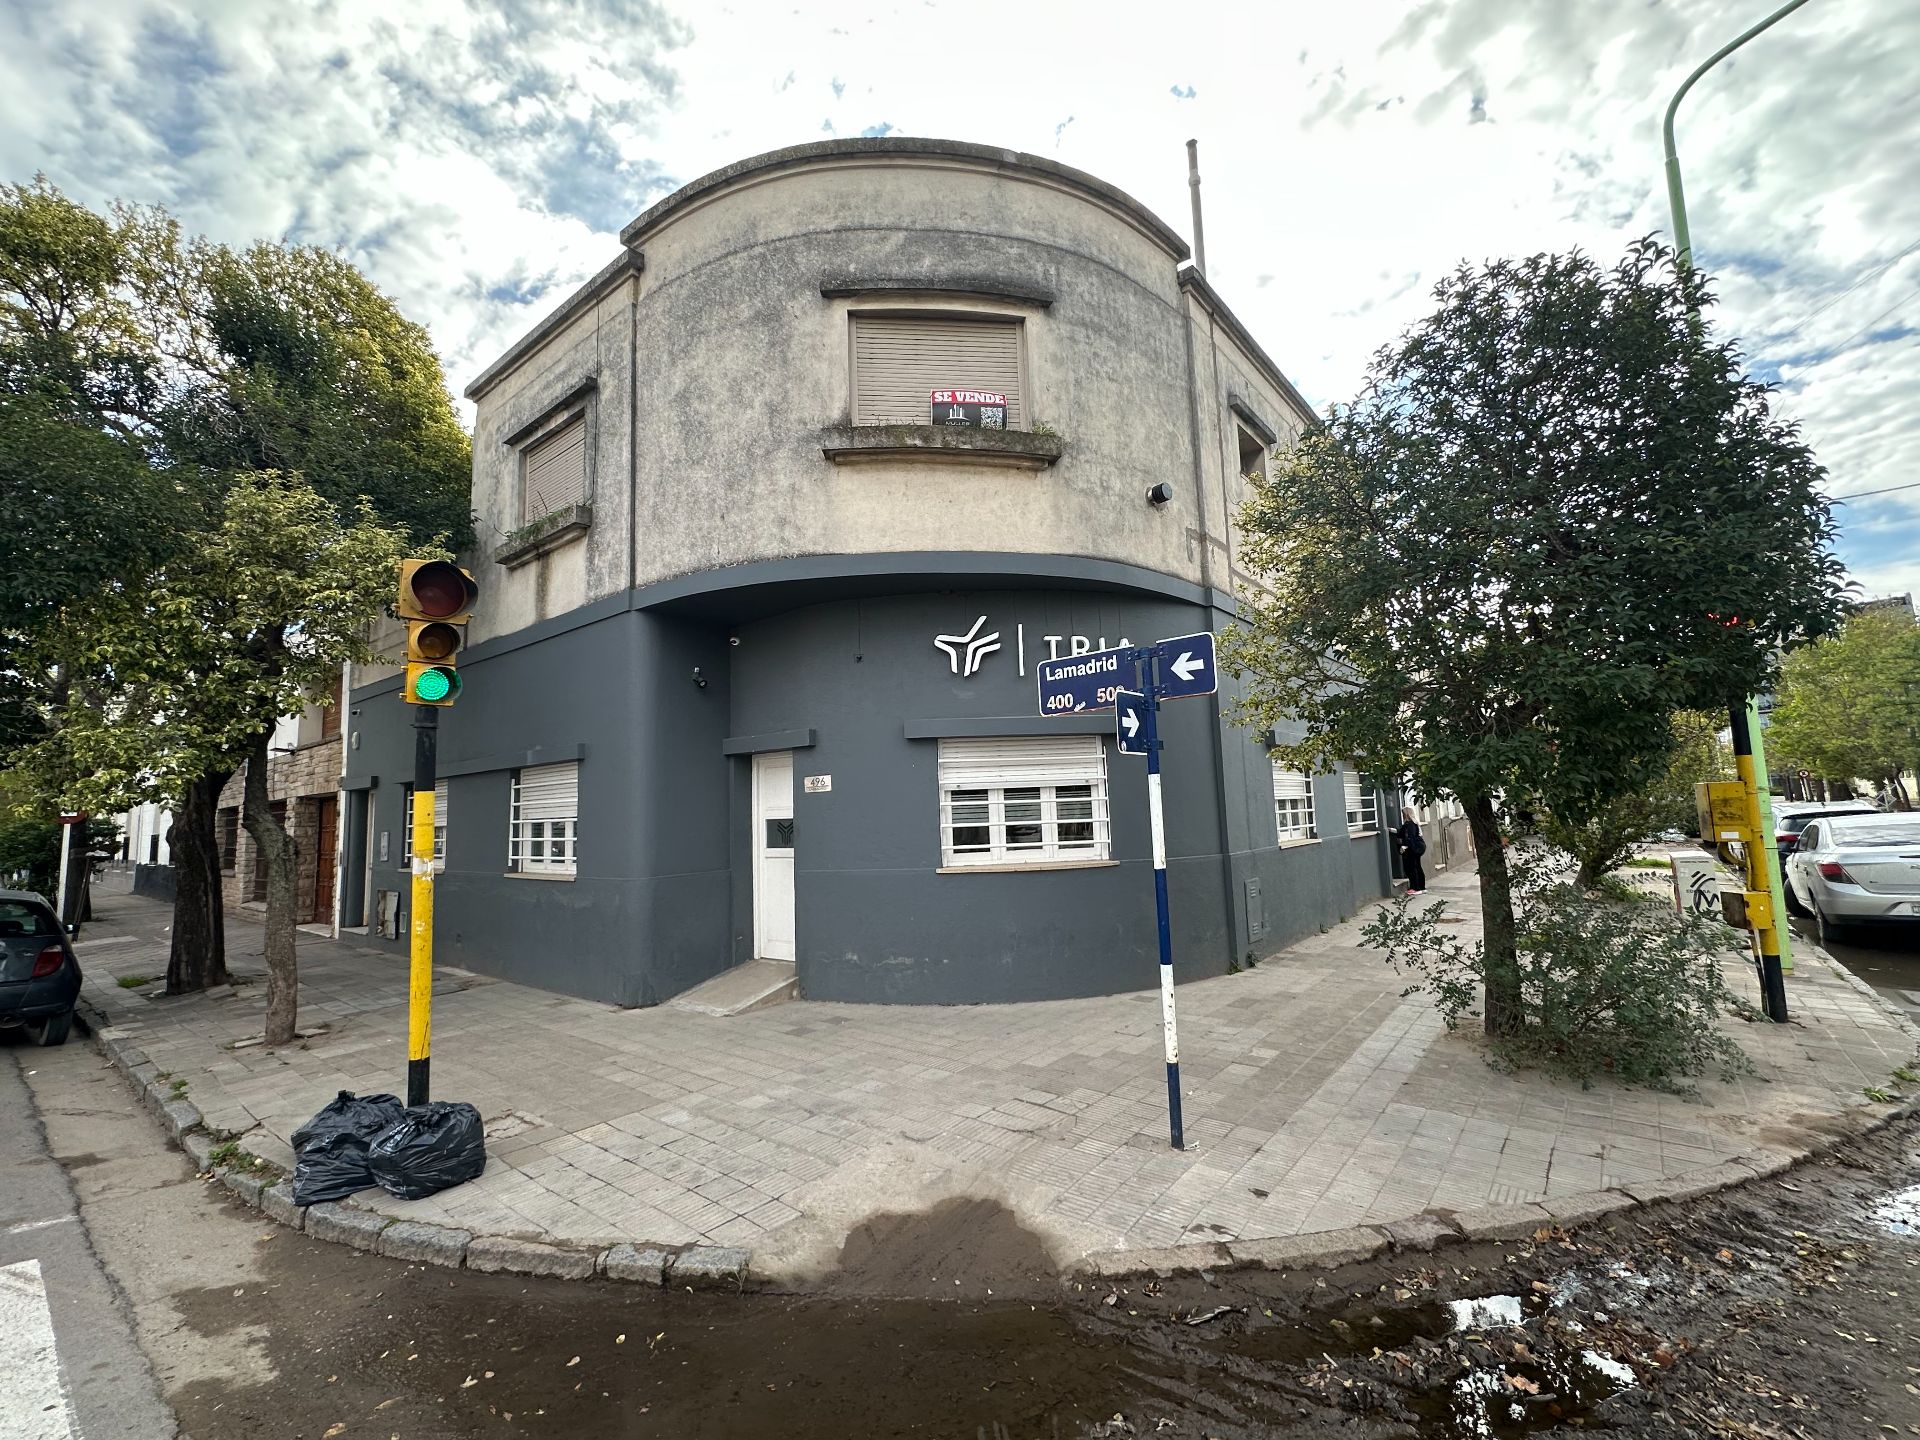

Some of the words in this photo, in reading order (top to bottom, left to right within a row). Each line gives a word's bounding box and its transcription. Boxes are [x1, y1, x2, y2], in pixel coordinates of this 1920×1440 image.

[935, 391, 952, 402] SE
[955, 391, 1004, 403] VENDE
[1045, 655, 1118, 681] Lamadrid
[1046, 693, 1073, 709] 400
[810, 776, 826, 787] 496
